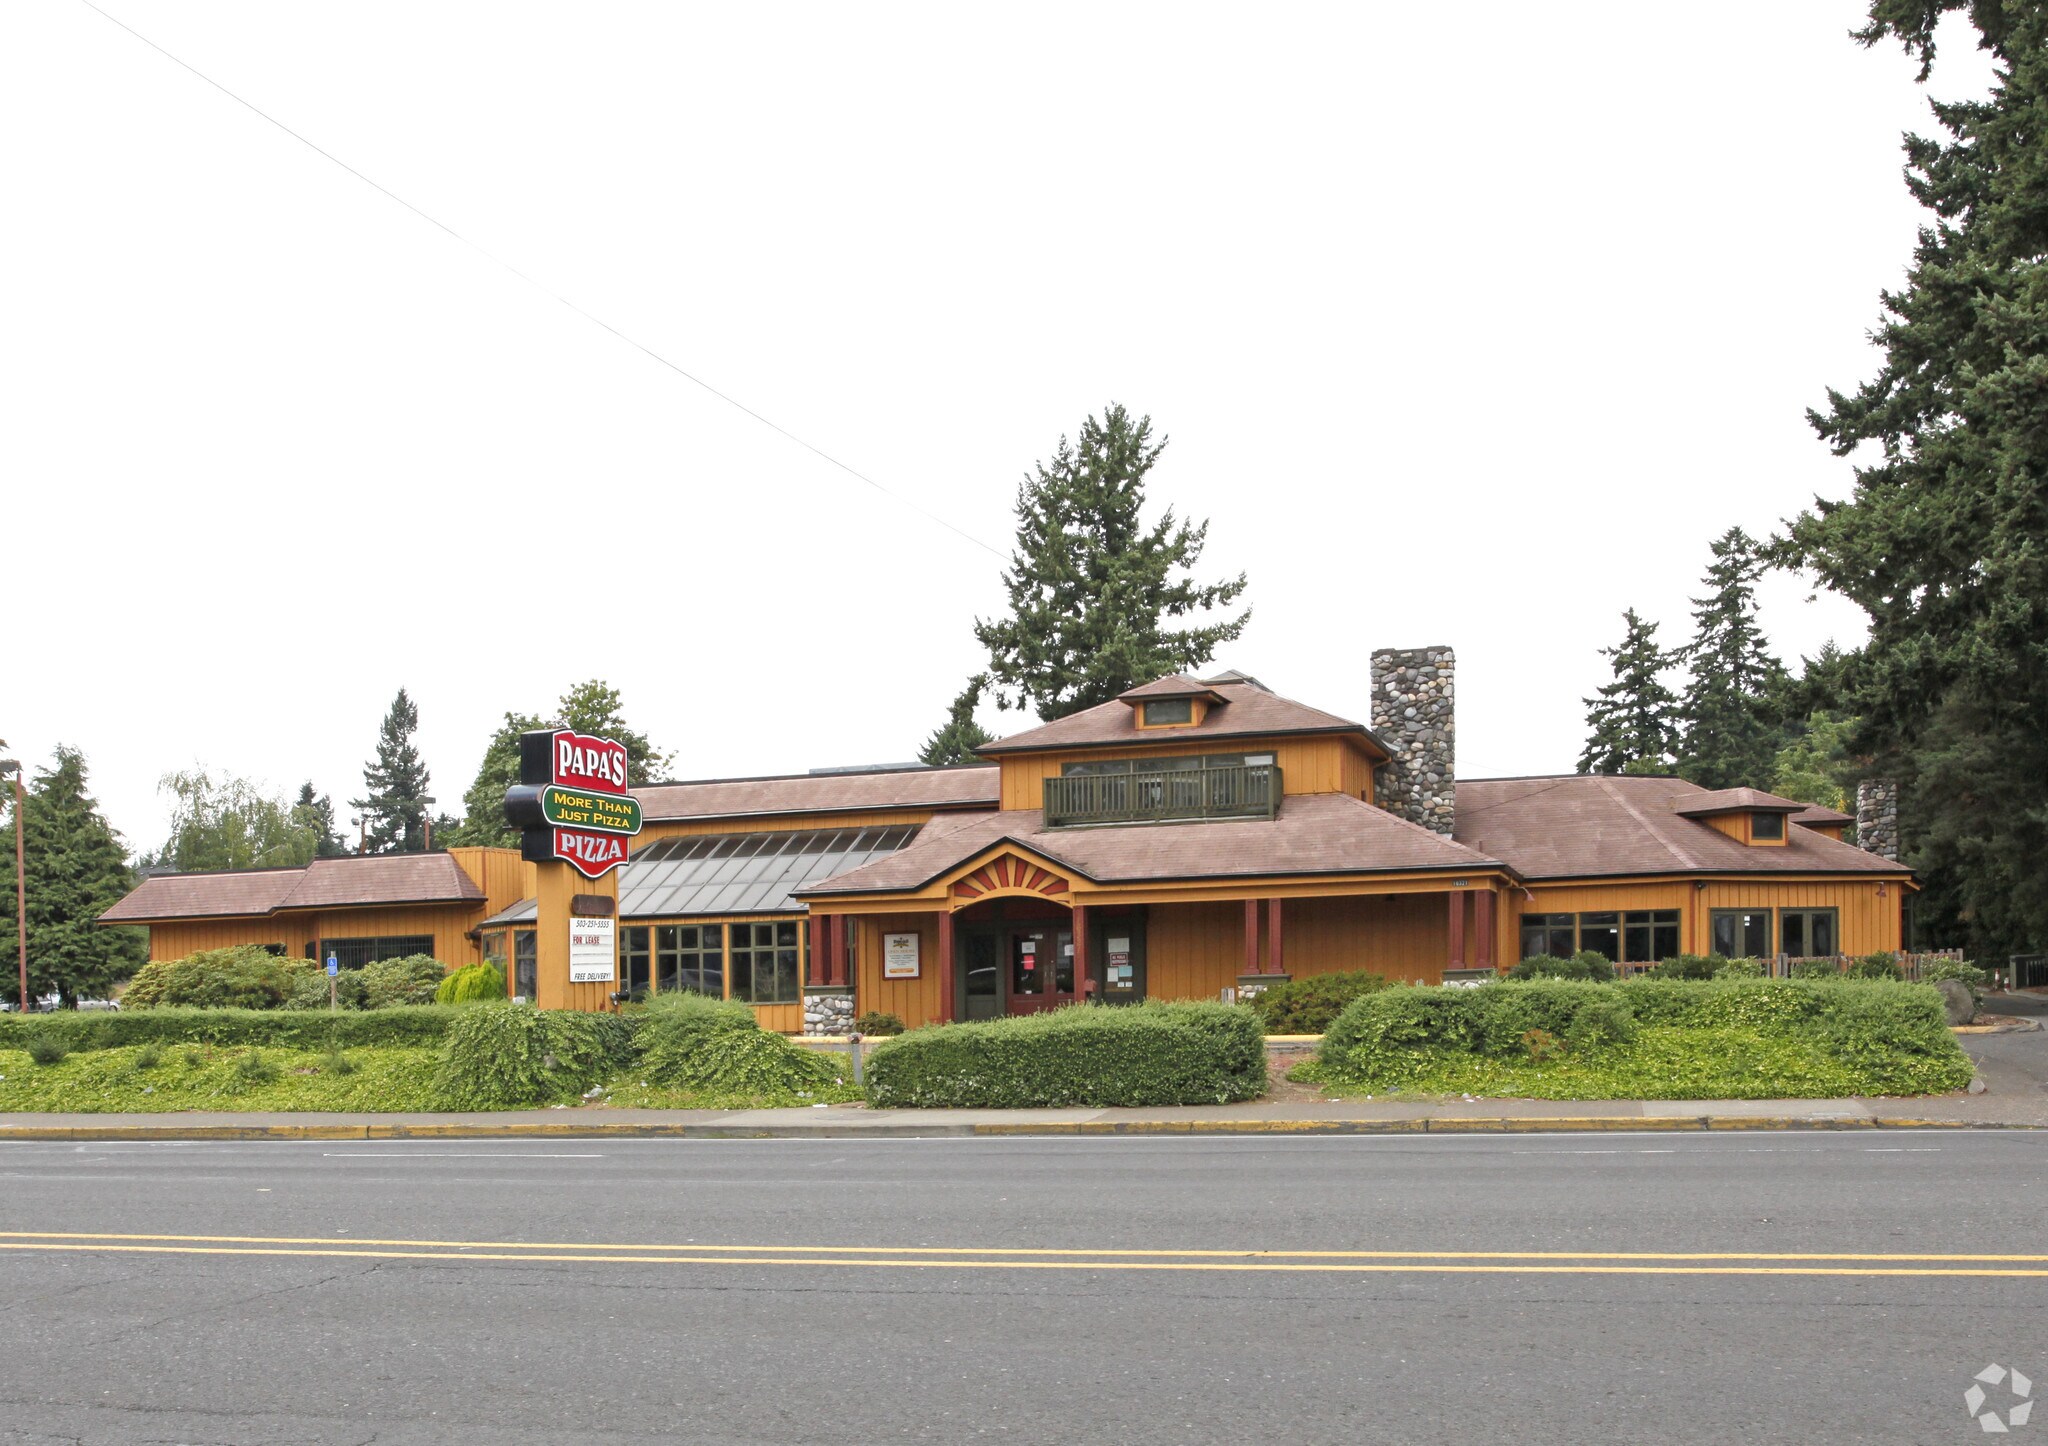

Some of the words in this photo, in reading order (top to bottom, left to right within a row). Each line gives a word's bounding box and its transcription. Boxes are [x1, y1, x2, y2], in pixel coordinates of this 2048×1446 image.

[559, 740, 624, 786] PAPA'S
[561, 833, 622, 863] PIZZA
[576, 920, 609, 928] 503-251-5555
[573, 936, 582, 944] FOR
[585, 936, 600, 944] LEASE
